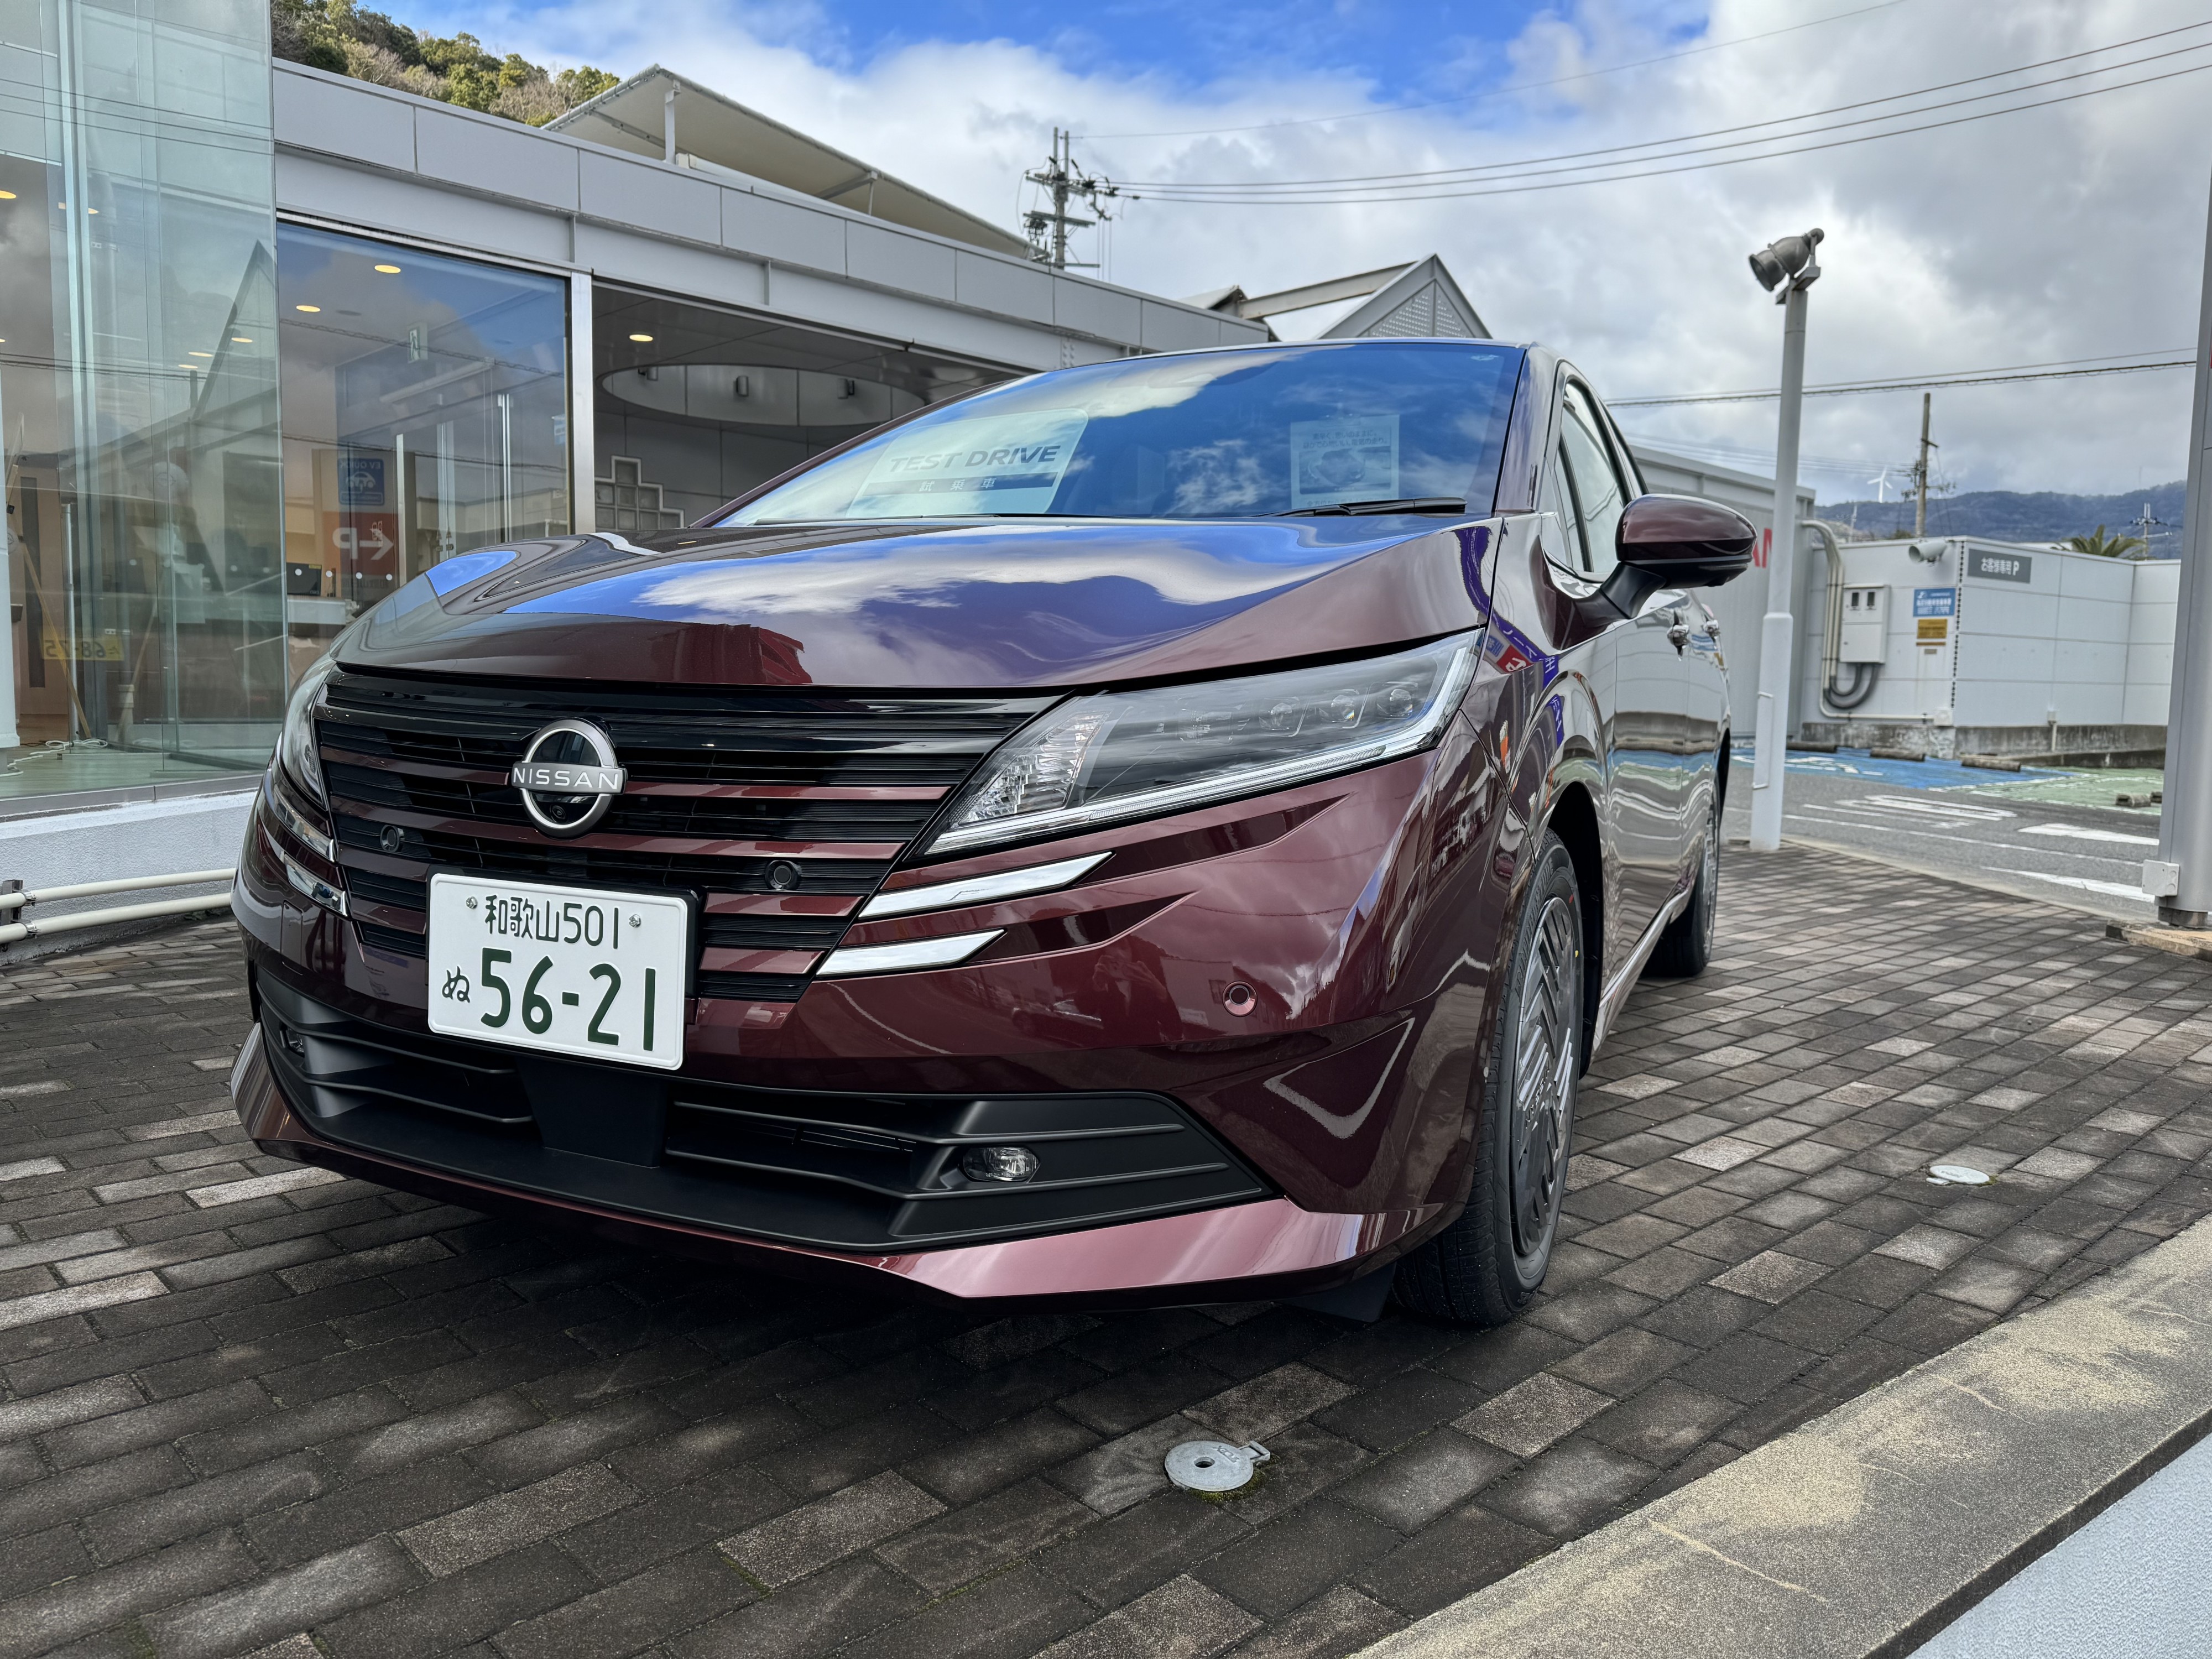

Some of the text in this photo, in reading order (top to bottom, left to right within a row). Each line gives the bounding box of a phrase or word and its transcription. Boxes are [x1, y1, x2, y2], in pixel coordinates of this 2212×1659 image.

[890, 445, 1061, 472] TEST DRIVE
[919, 477, 997, 492] 試乗車
[512, 766, 620, 791] NISSAN
[441, 946, 656, 1052] ぬ 56-21
